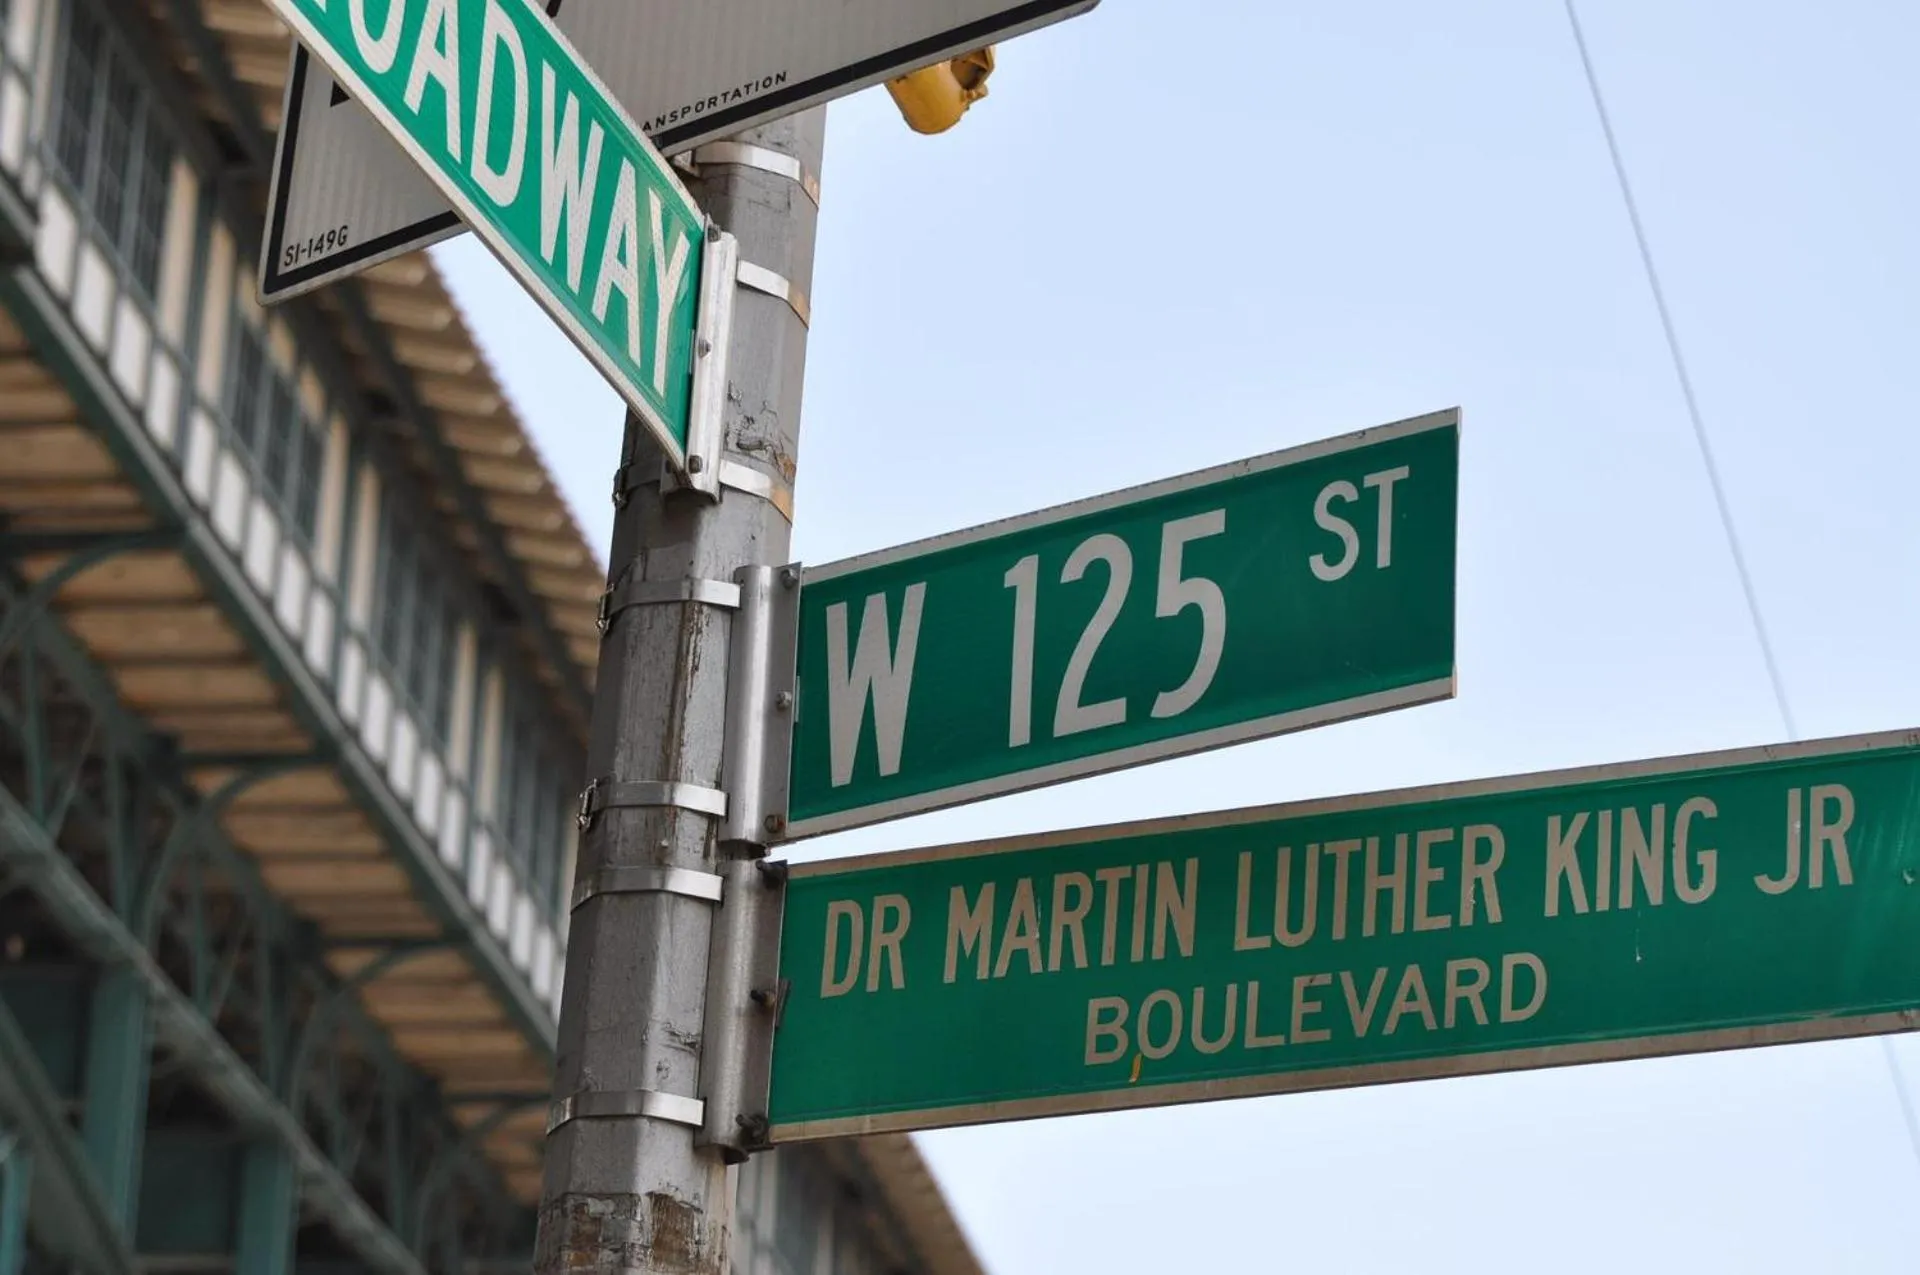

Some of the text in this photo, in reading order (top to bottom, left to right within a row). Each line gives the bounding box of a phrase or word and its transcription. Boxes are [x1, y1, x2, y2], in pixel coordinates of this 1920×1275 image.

[283, 225, 349, 267] SI-149G
[314, 0, 691, 399] ADWAY
[826, 466, 1410, 788] W 125 ST
[820, 784, 1855, 999] DR MARTIN LUTHER KING JR
[1084, 952, 1549, 1066] BOULEVARD
